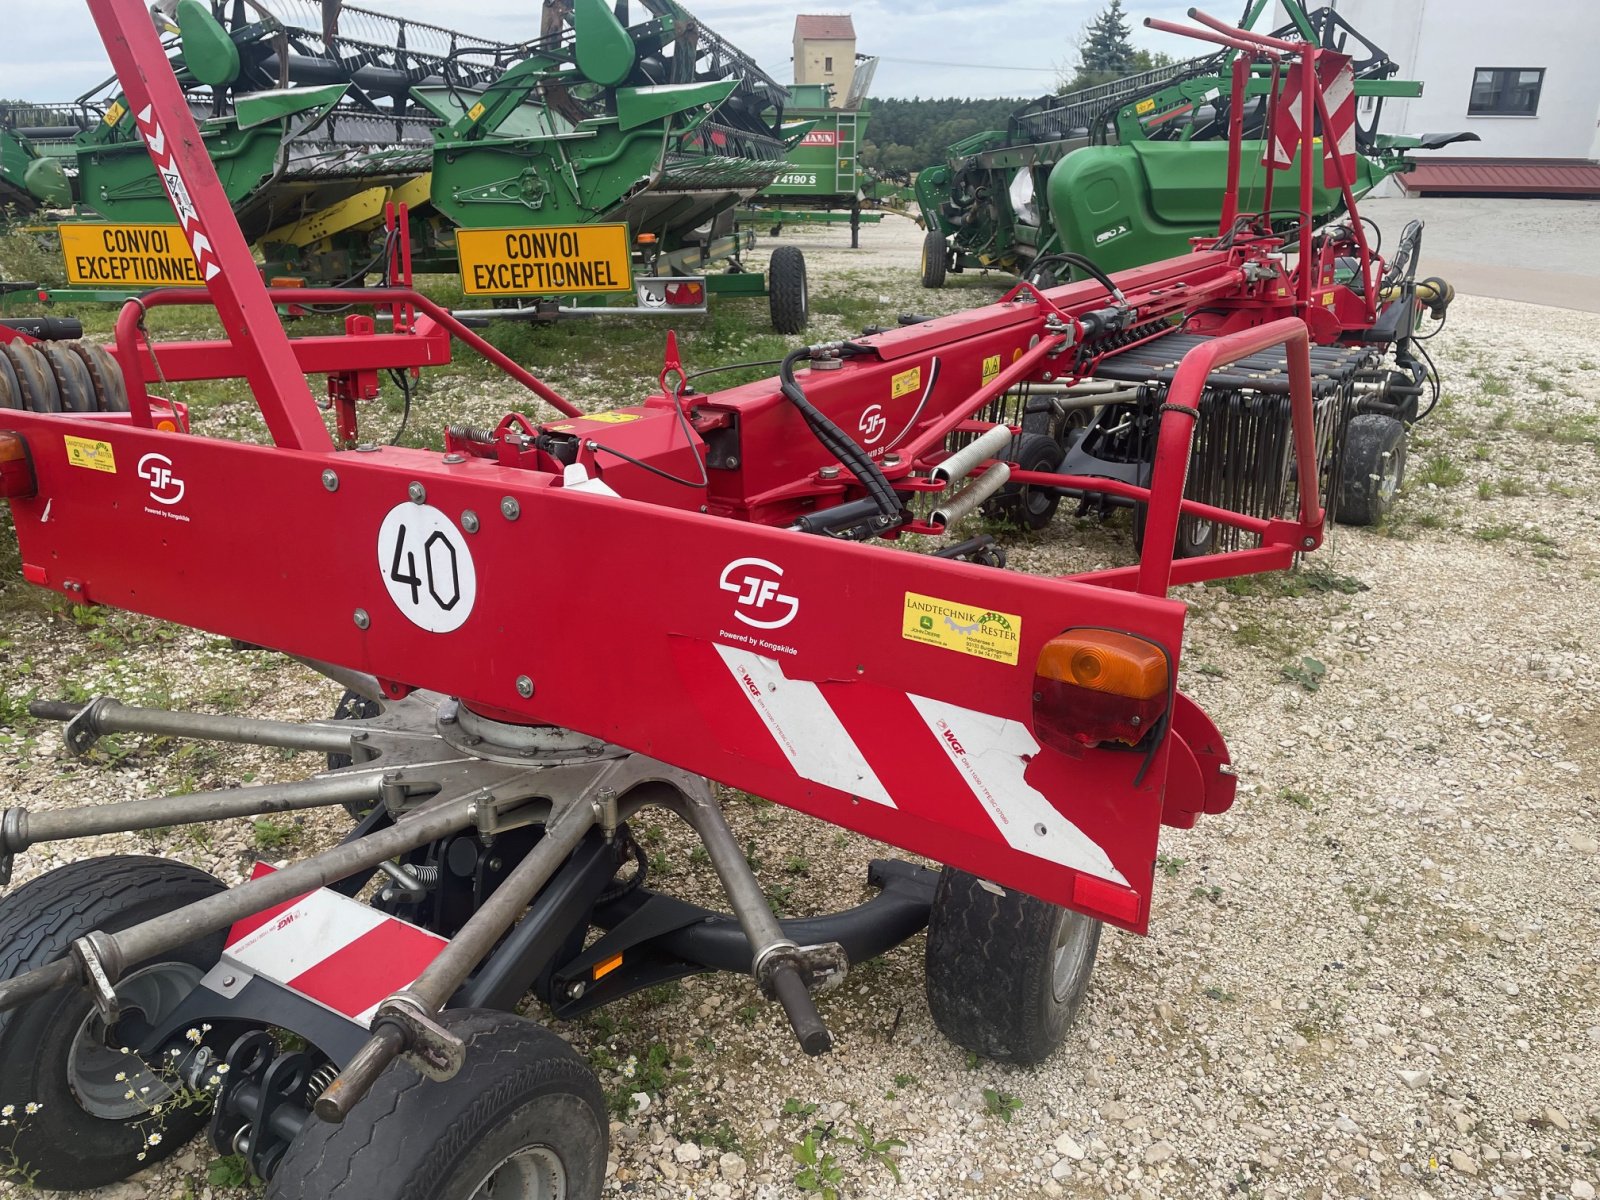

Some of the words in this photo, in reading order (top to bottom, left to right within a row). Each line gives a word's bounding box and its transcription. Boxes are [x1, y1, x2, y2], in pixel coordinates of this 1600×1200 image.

[780, 175, 806, 184] 4190
[809, 175, 817, 184] S
[103, 229, 170, 254] CONVOI
[505, 231, 580, 260] CONVOI
[473, 260, 618, 290] EXCEPTIONNEL
[144, 506, 161, 516] Powered
[161, 510, 168, 518] by
[167, 512, 190, 522] Kongskilde
[391, 523, 461, 612] 40
[907, 598, 977, 624] LANDTECHNIK
[719, 629, 748, 643] Powered
[748, 636, 758, 647] by
[758, 639, 798, 656] Kongskilde
[981, 624, 1017, 641] RESTER
[743, 673, 762, 697] WGF
[943, 729, 967, 756] WGF
[961, 757, 971, 769] DIN
[276, 914, 294, 931] WGF
